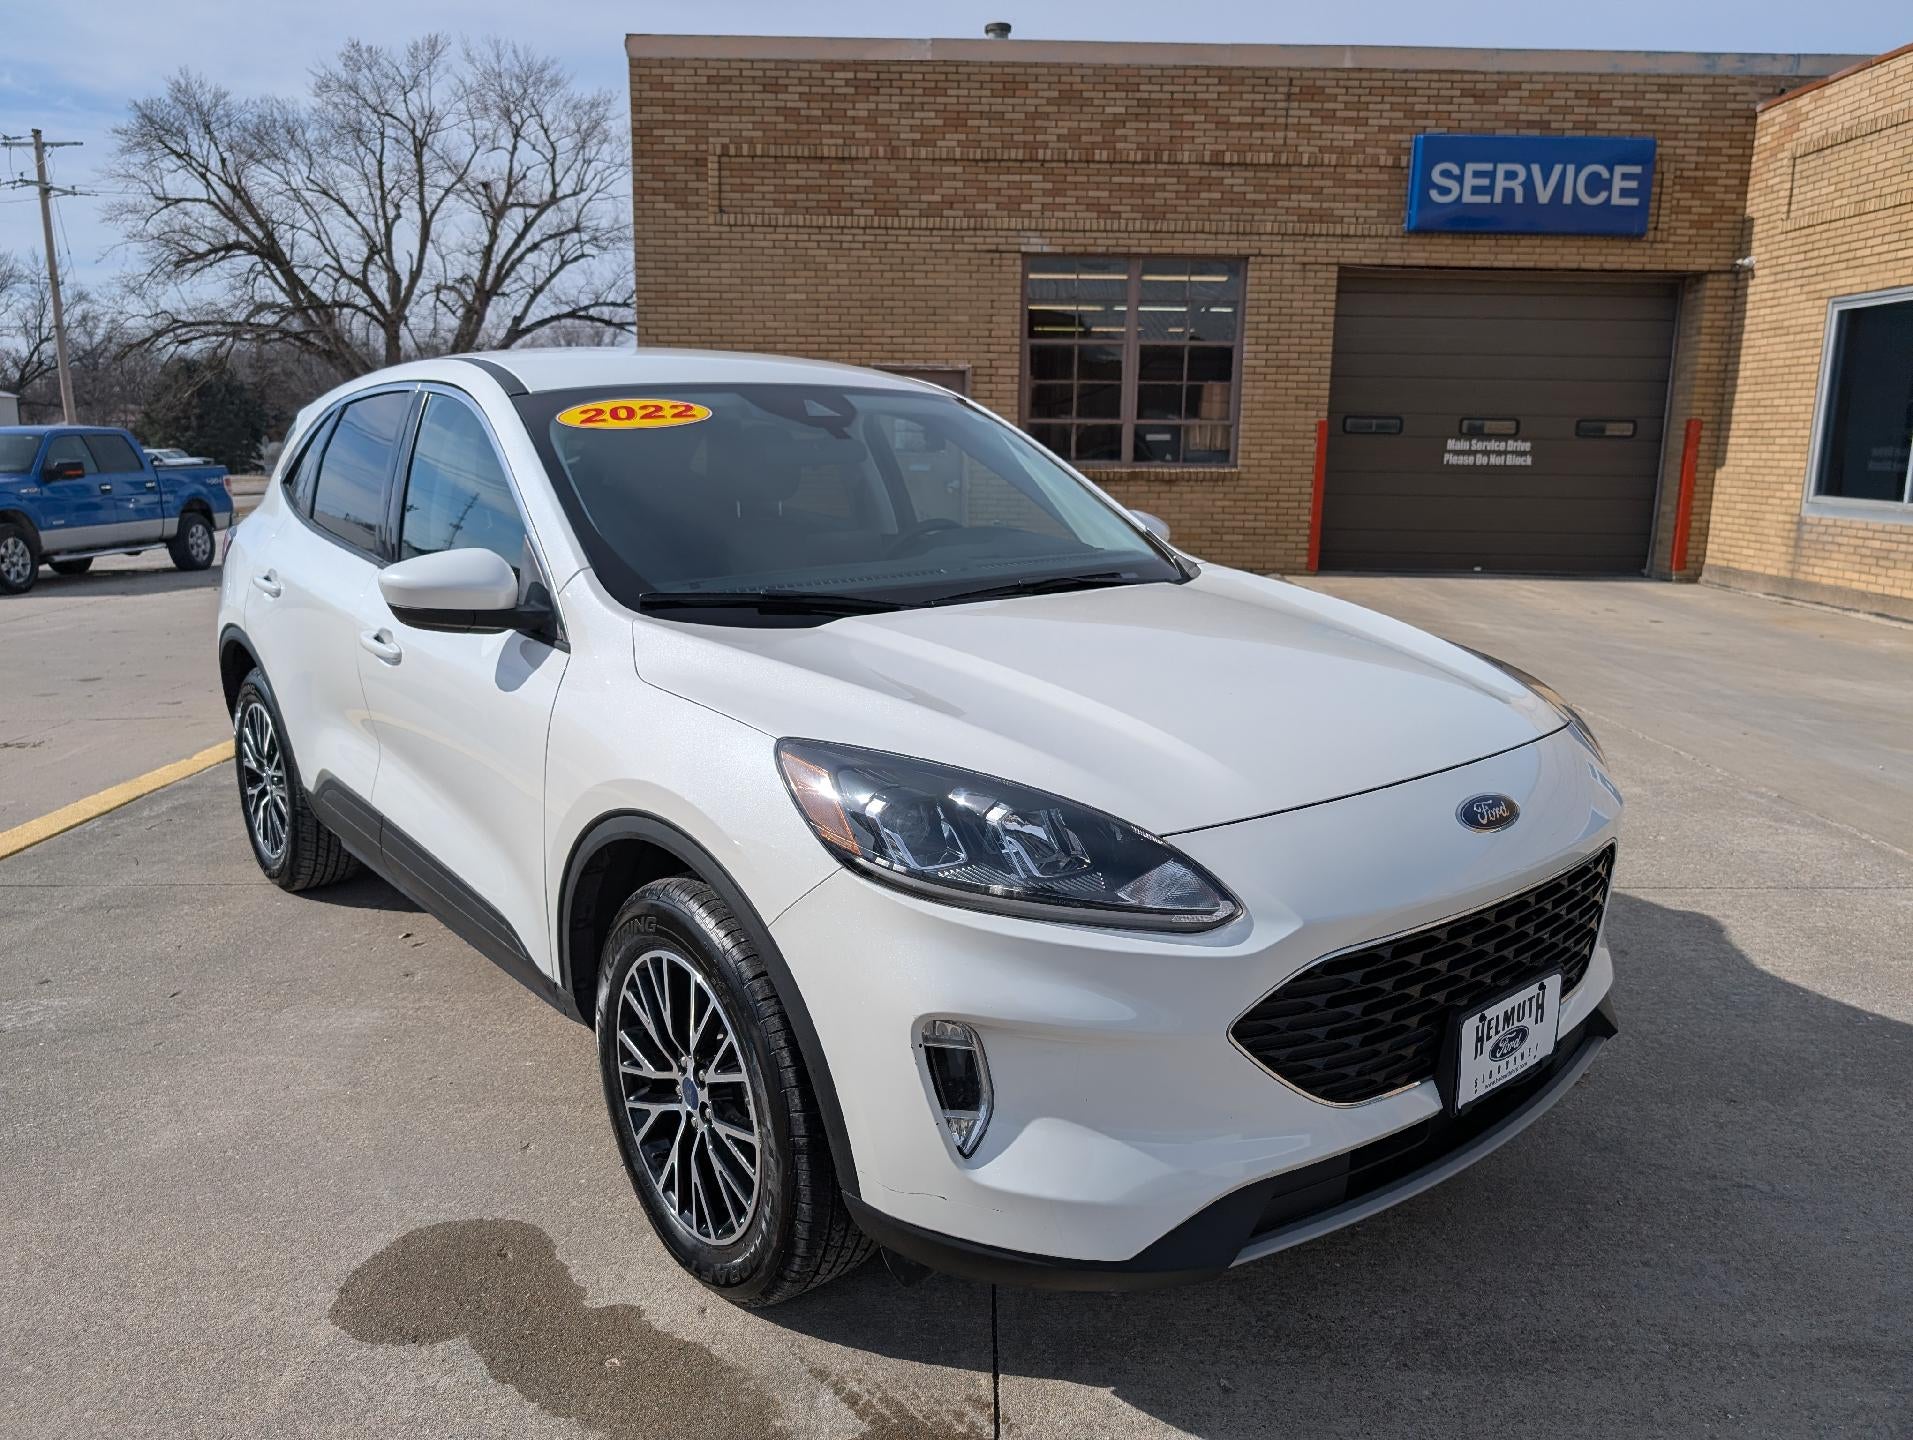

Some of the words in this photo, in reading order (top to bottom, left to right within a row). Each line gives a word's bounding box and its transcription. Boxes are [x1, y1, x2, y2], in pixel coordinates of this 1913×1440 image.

[1428, 161, 1642, 206] SERVICE
[579, 404, 697, 425] 2022
[1446, 438, 1470, 450] Main
[1471, 438, 1506, 451] Service
[1507, 440, 1531, 451] Drive
[1443, 452, 1474, 465] Please
[1475, 453, 1488, 466] Do
[1489, 454, 1505, 466] Not
[1505, 454, 1532, 466] Block
[1473, 799, 1510, 824] Ford
[1474, 988, 1546, 1061] HELMUTH
[1496, 1032, 1523, 1055] Ford
